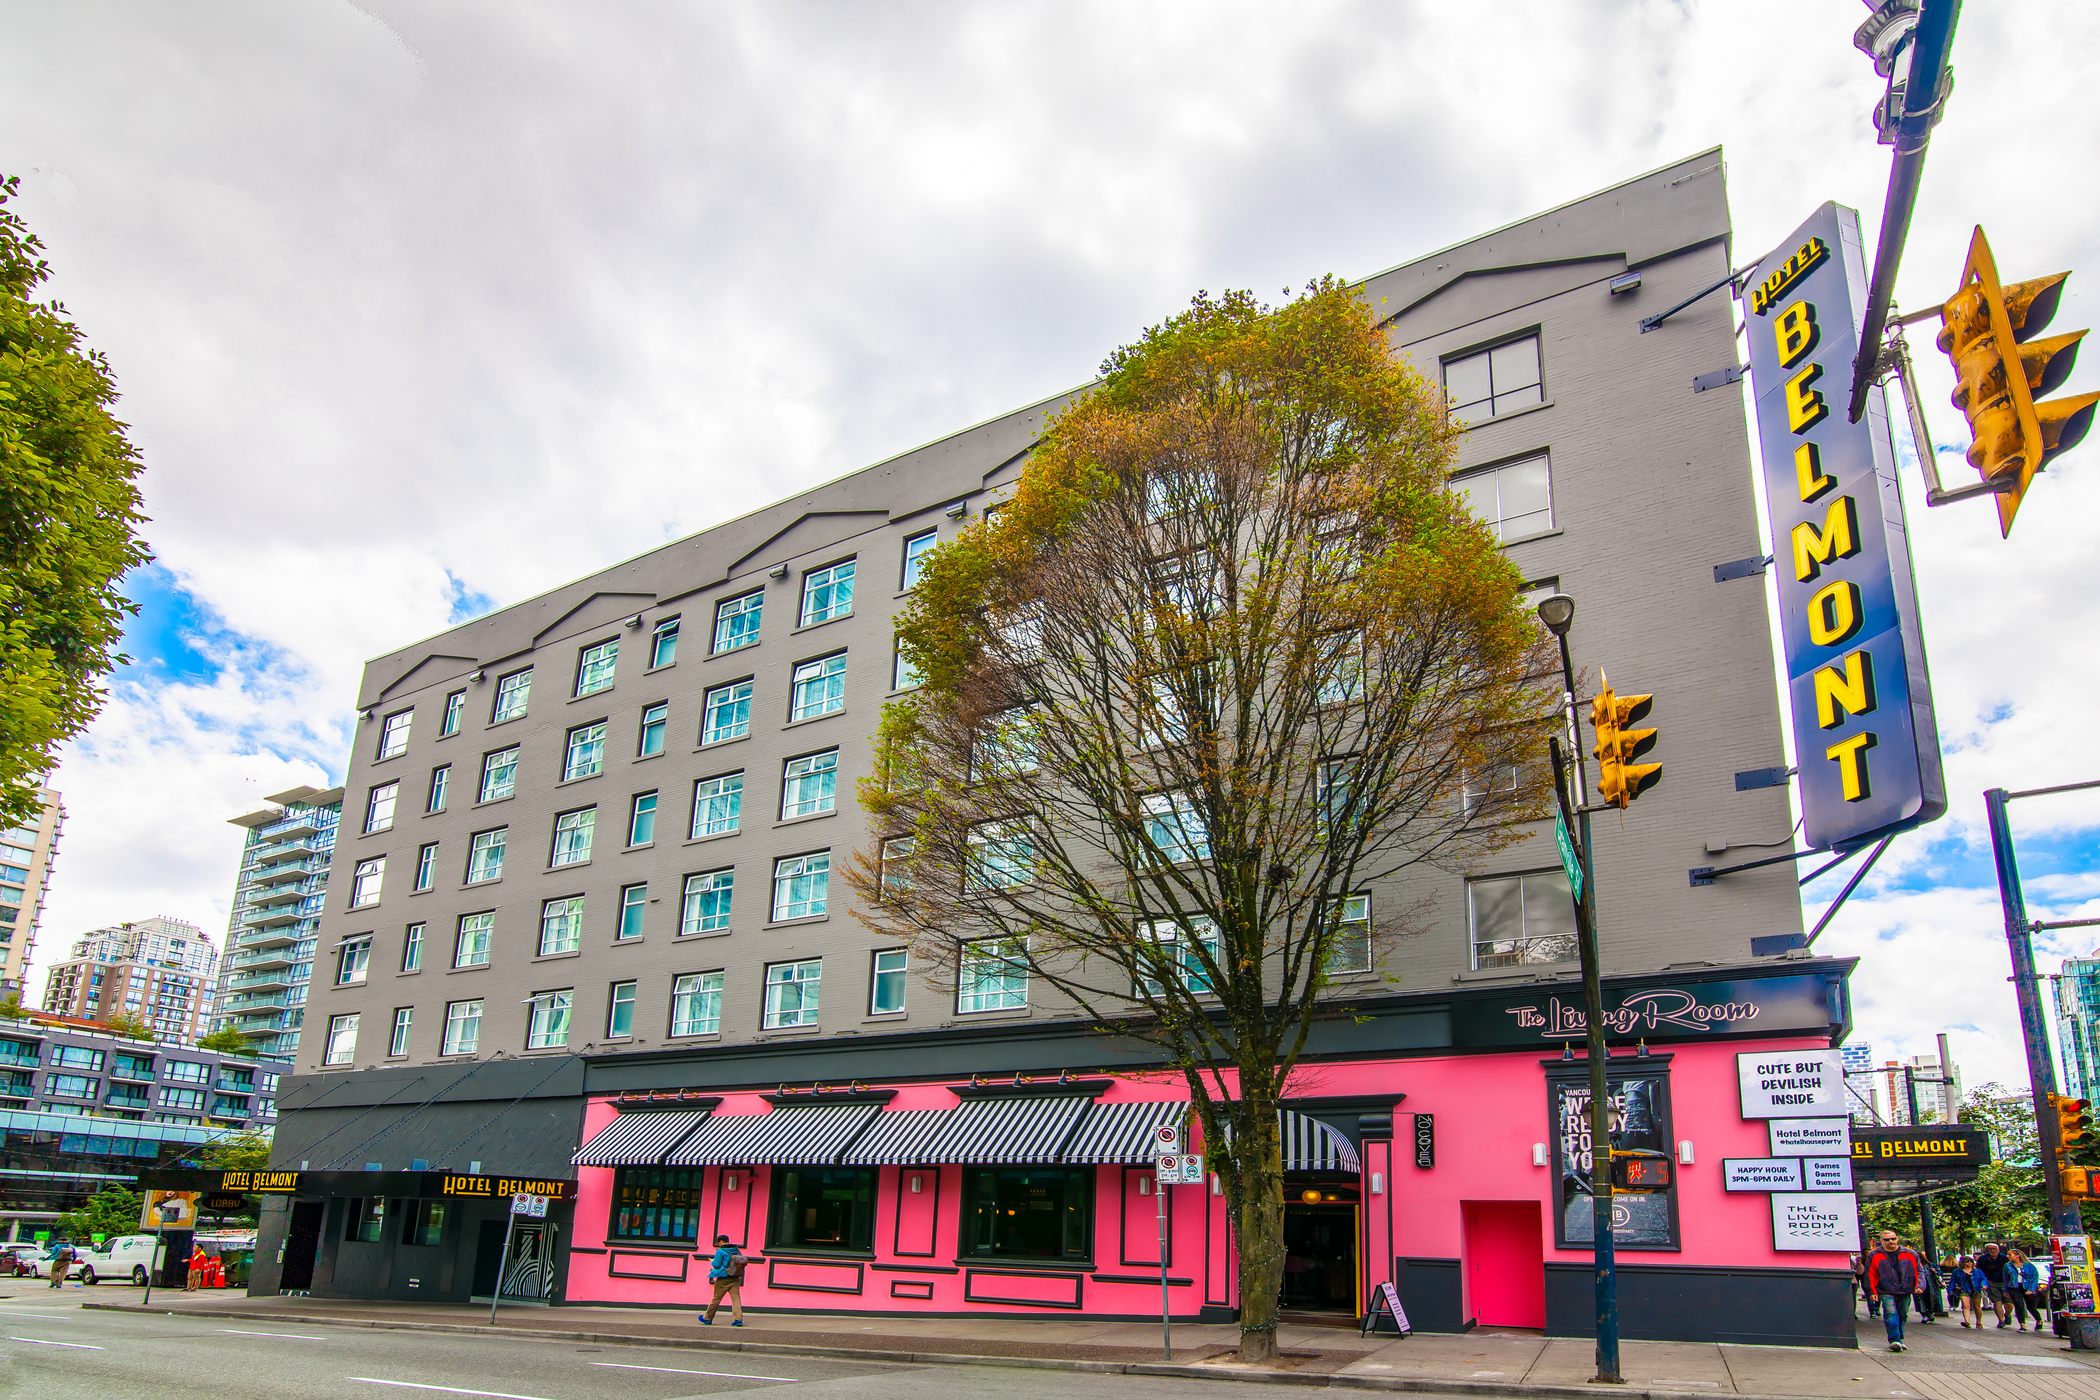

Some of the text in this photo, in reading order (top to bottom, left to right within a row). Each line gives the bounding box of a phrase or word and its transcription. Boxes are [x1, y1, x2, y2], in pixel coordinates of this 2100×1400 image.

[1752, 236, 1824, 315] HOTEL
[1774, 301, 1874, 802] BELMONT
[1505, 989, 1760, 1037] The Livng Room
[1757, 1062, 1823, 1075] CUTE BUT
[1762, 1078, 1822, 1090] DEVILISH
[1771, 1094, 1815, 1105] INSIDE
[1568, 1133, 1592, 1151] FO
[1803, 1129, 1842, 1137] Belmont
[1850, 1140, 1967, 1157] EL BELMONT
[1568, 1151, 1593, 1170] YO
[222, 1173, 299, 1191] HOTEL BELMONT
[443, 1176, 565, 1198] HOTEL BELMONT
[211, 1199, 240, 1208] LOBBY
